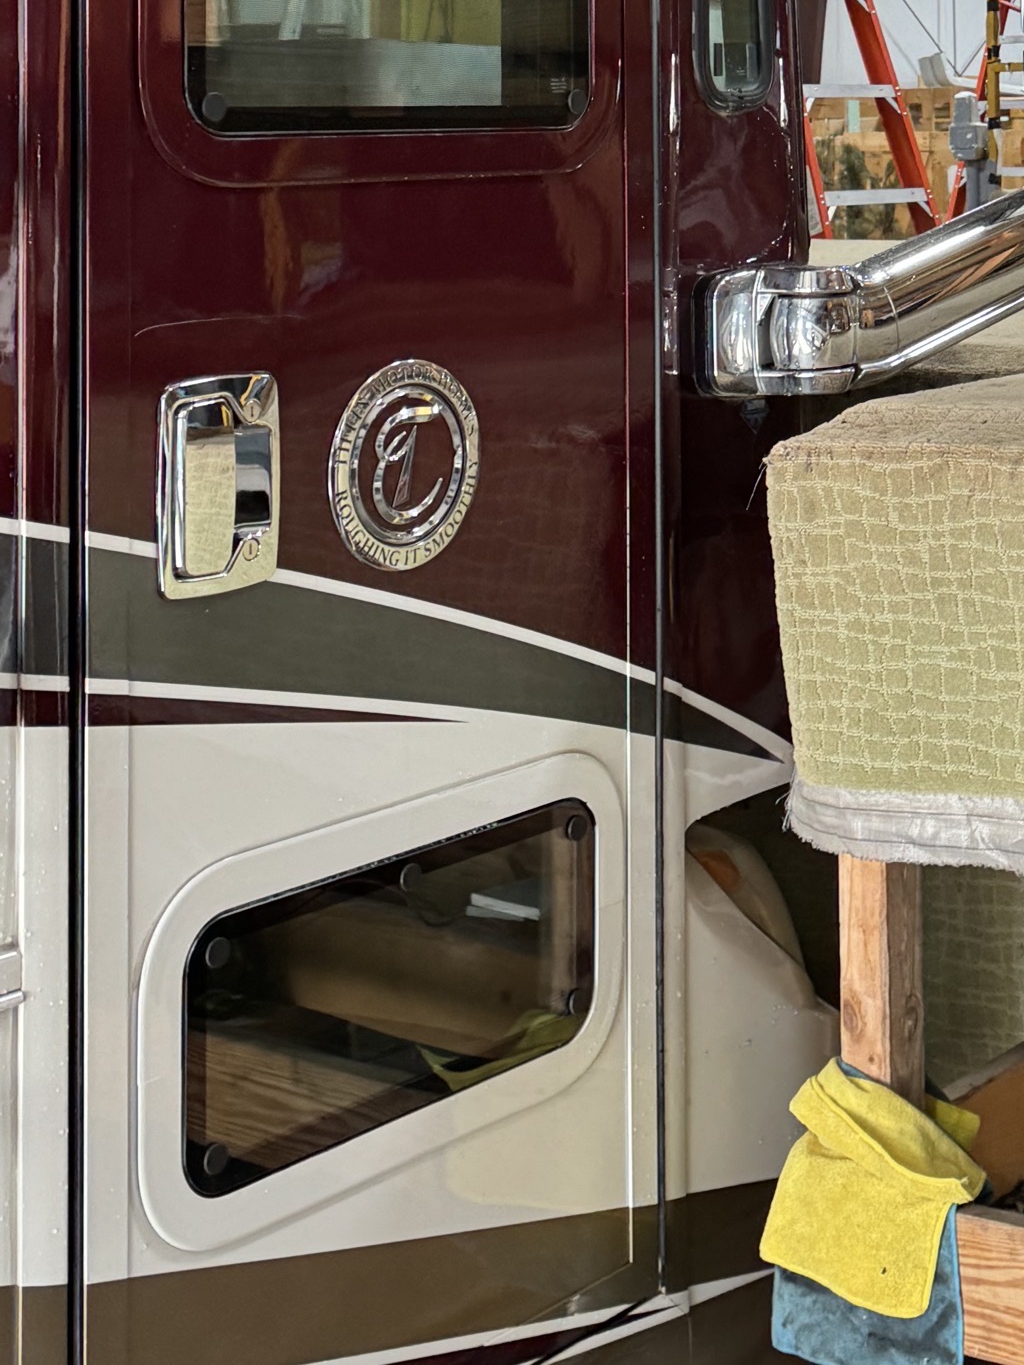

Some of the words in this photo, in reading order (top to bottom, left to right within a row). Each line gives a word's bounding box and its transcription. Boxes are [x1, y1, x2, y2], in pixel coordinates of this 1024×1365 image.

[373, 364, 434, 396] MOTOR
[335, 489, 400, 567] ROUGHING
[404, 547, 420, 564] IT
[424, 458, 478, 558] SMOOTHLY
